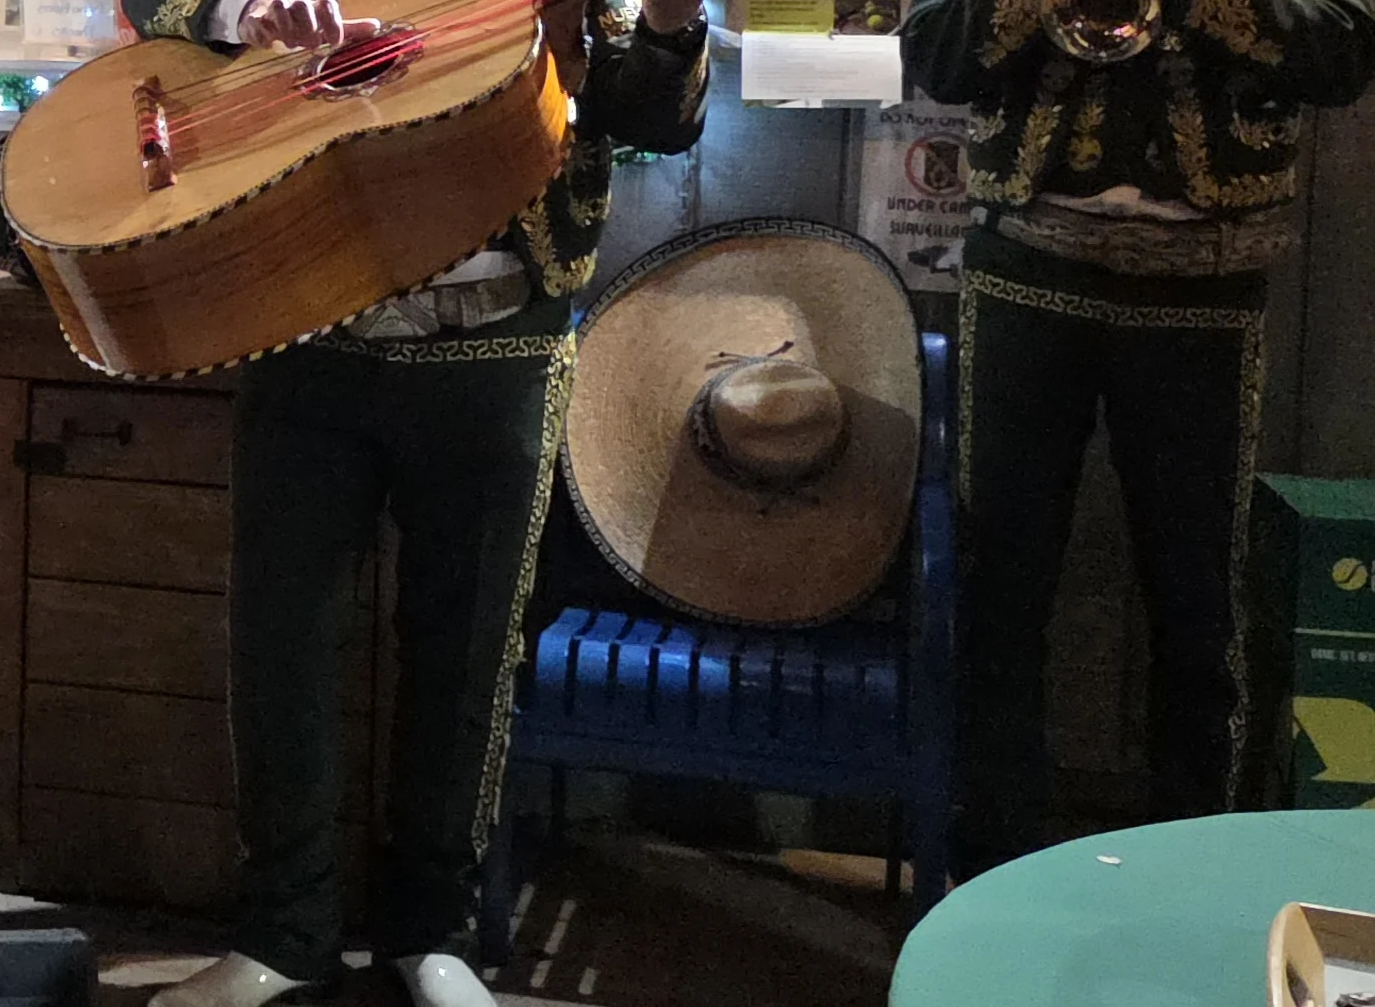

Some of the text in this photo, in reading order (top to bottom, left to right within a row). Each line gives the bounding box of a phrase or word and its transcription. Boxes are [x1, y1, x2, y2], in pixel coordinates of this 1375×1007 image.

[887, 197, 971, 215] UNDER CAM
[890, 220, 966, 238] SURVEILLA
